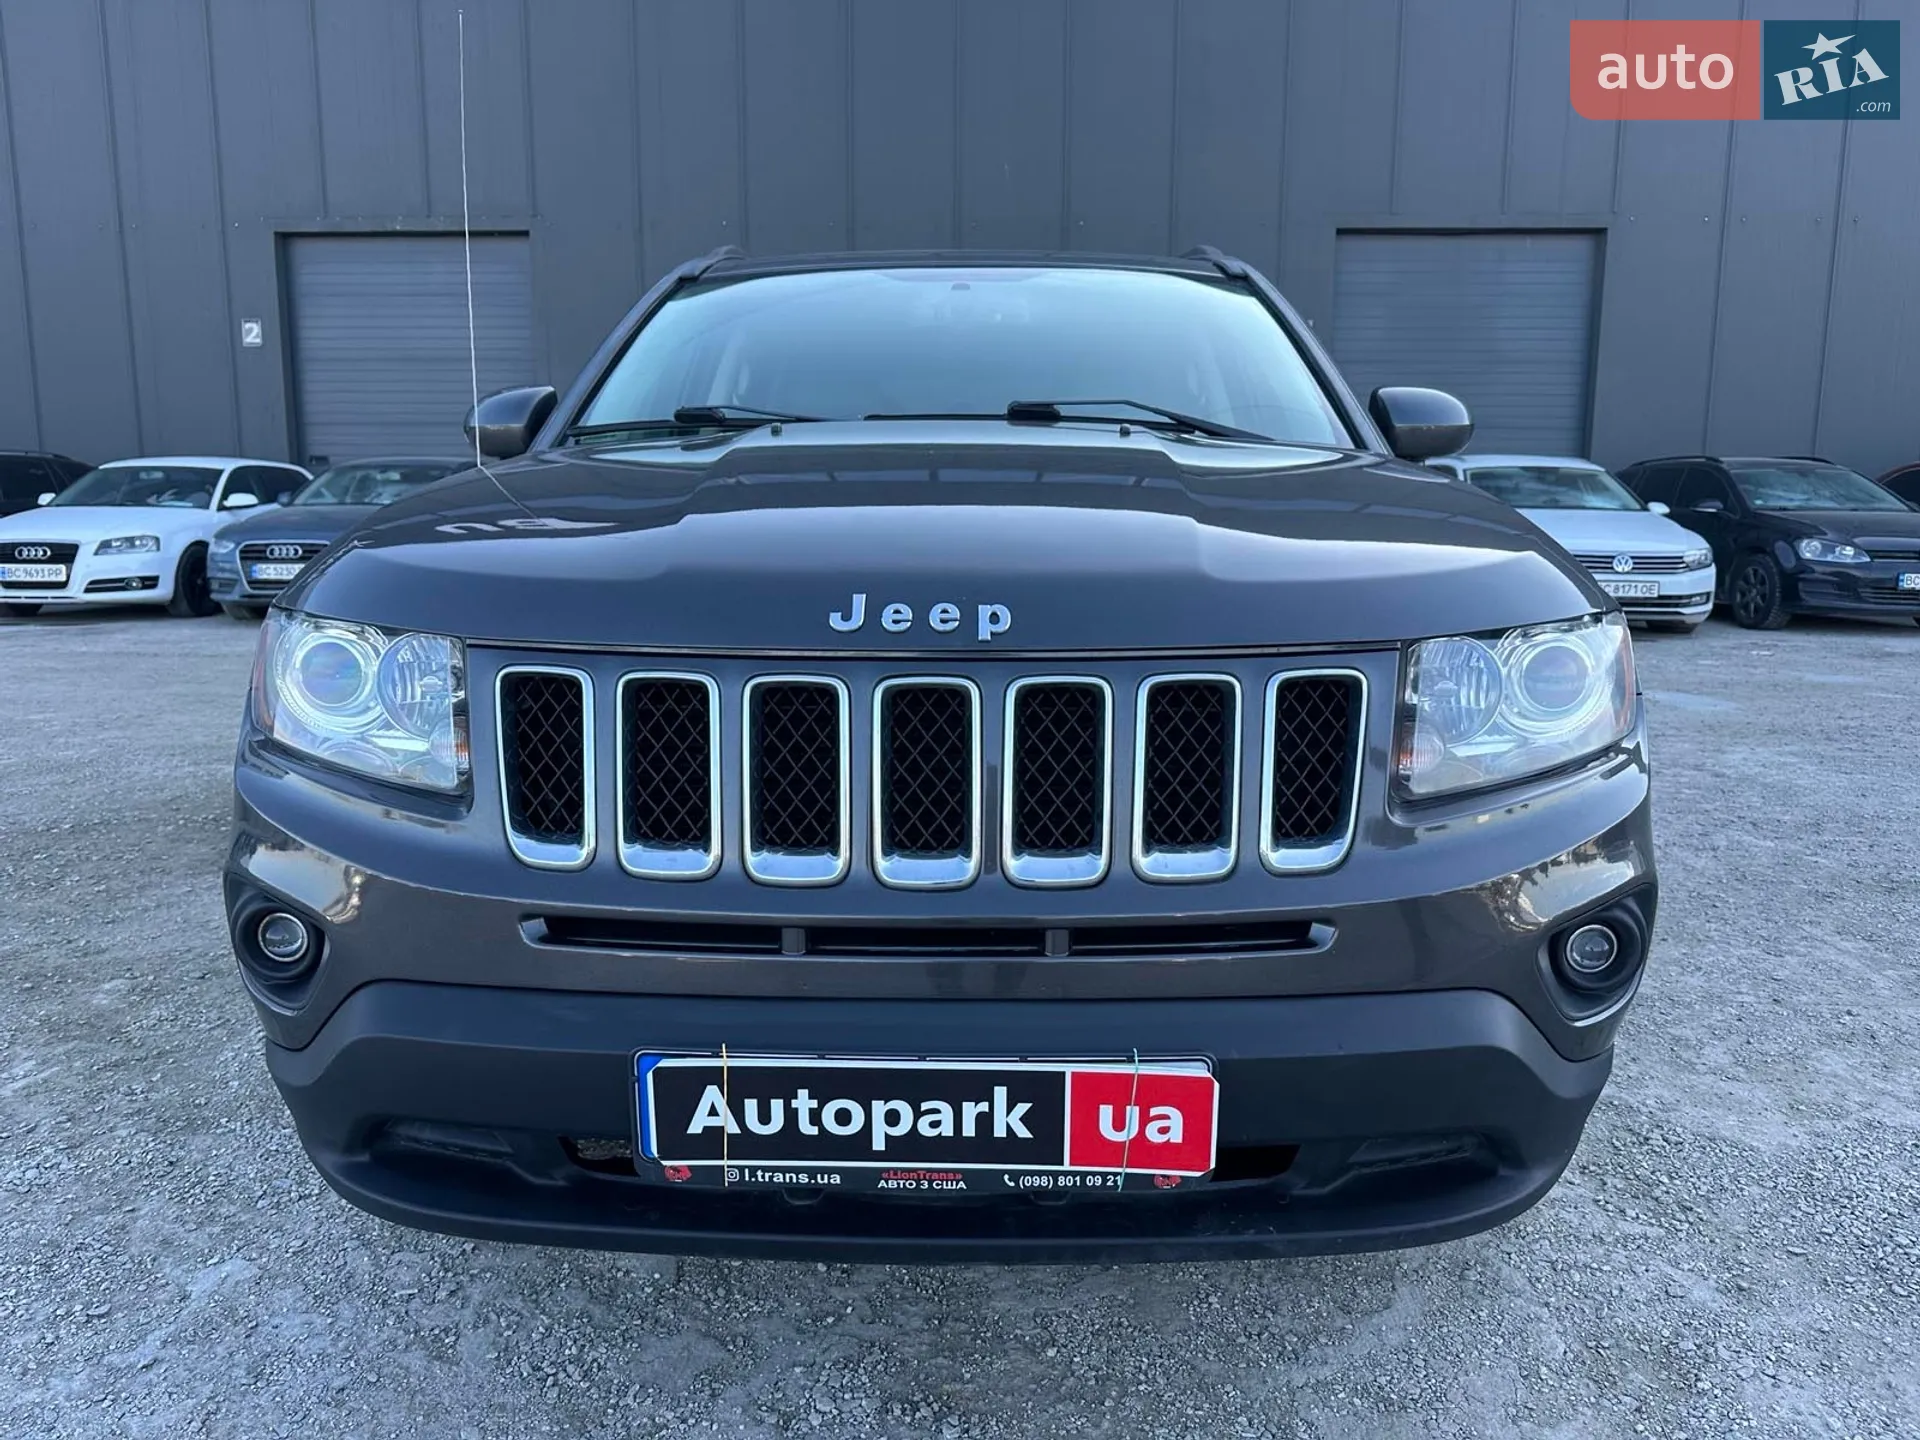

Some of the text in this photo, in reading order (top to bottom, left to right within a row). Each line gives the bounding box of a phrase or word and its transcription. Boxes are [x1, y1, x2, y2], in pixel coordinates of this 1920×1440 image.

[244, 322, 261, 343] 2
[1613, 583, 1639, 595] 8171
[828, 593, 1012, 642] Jeep
[686, 1084, 1184, 1151] Autopark ua
[877, 1179, 917, 1189] АВТО
[932, 1180, 967, 1190] США
[1019, 1175, 1122, 1189] (098) 801 09 21
